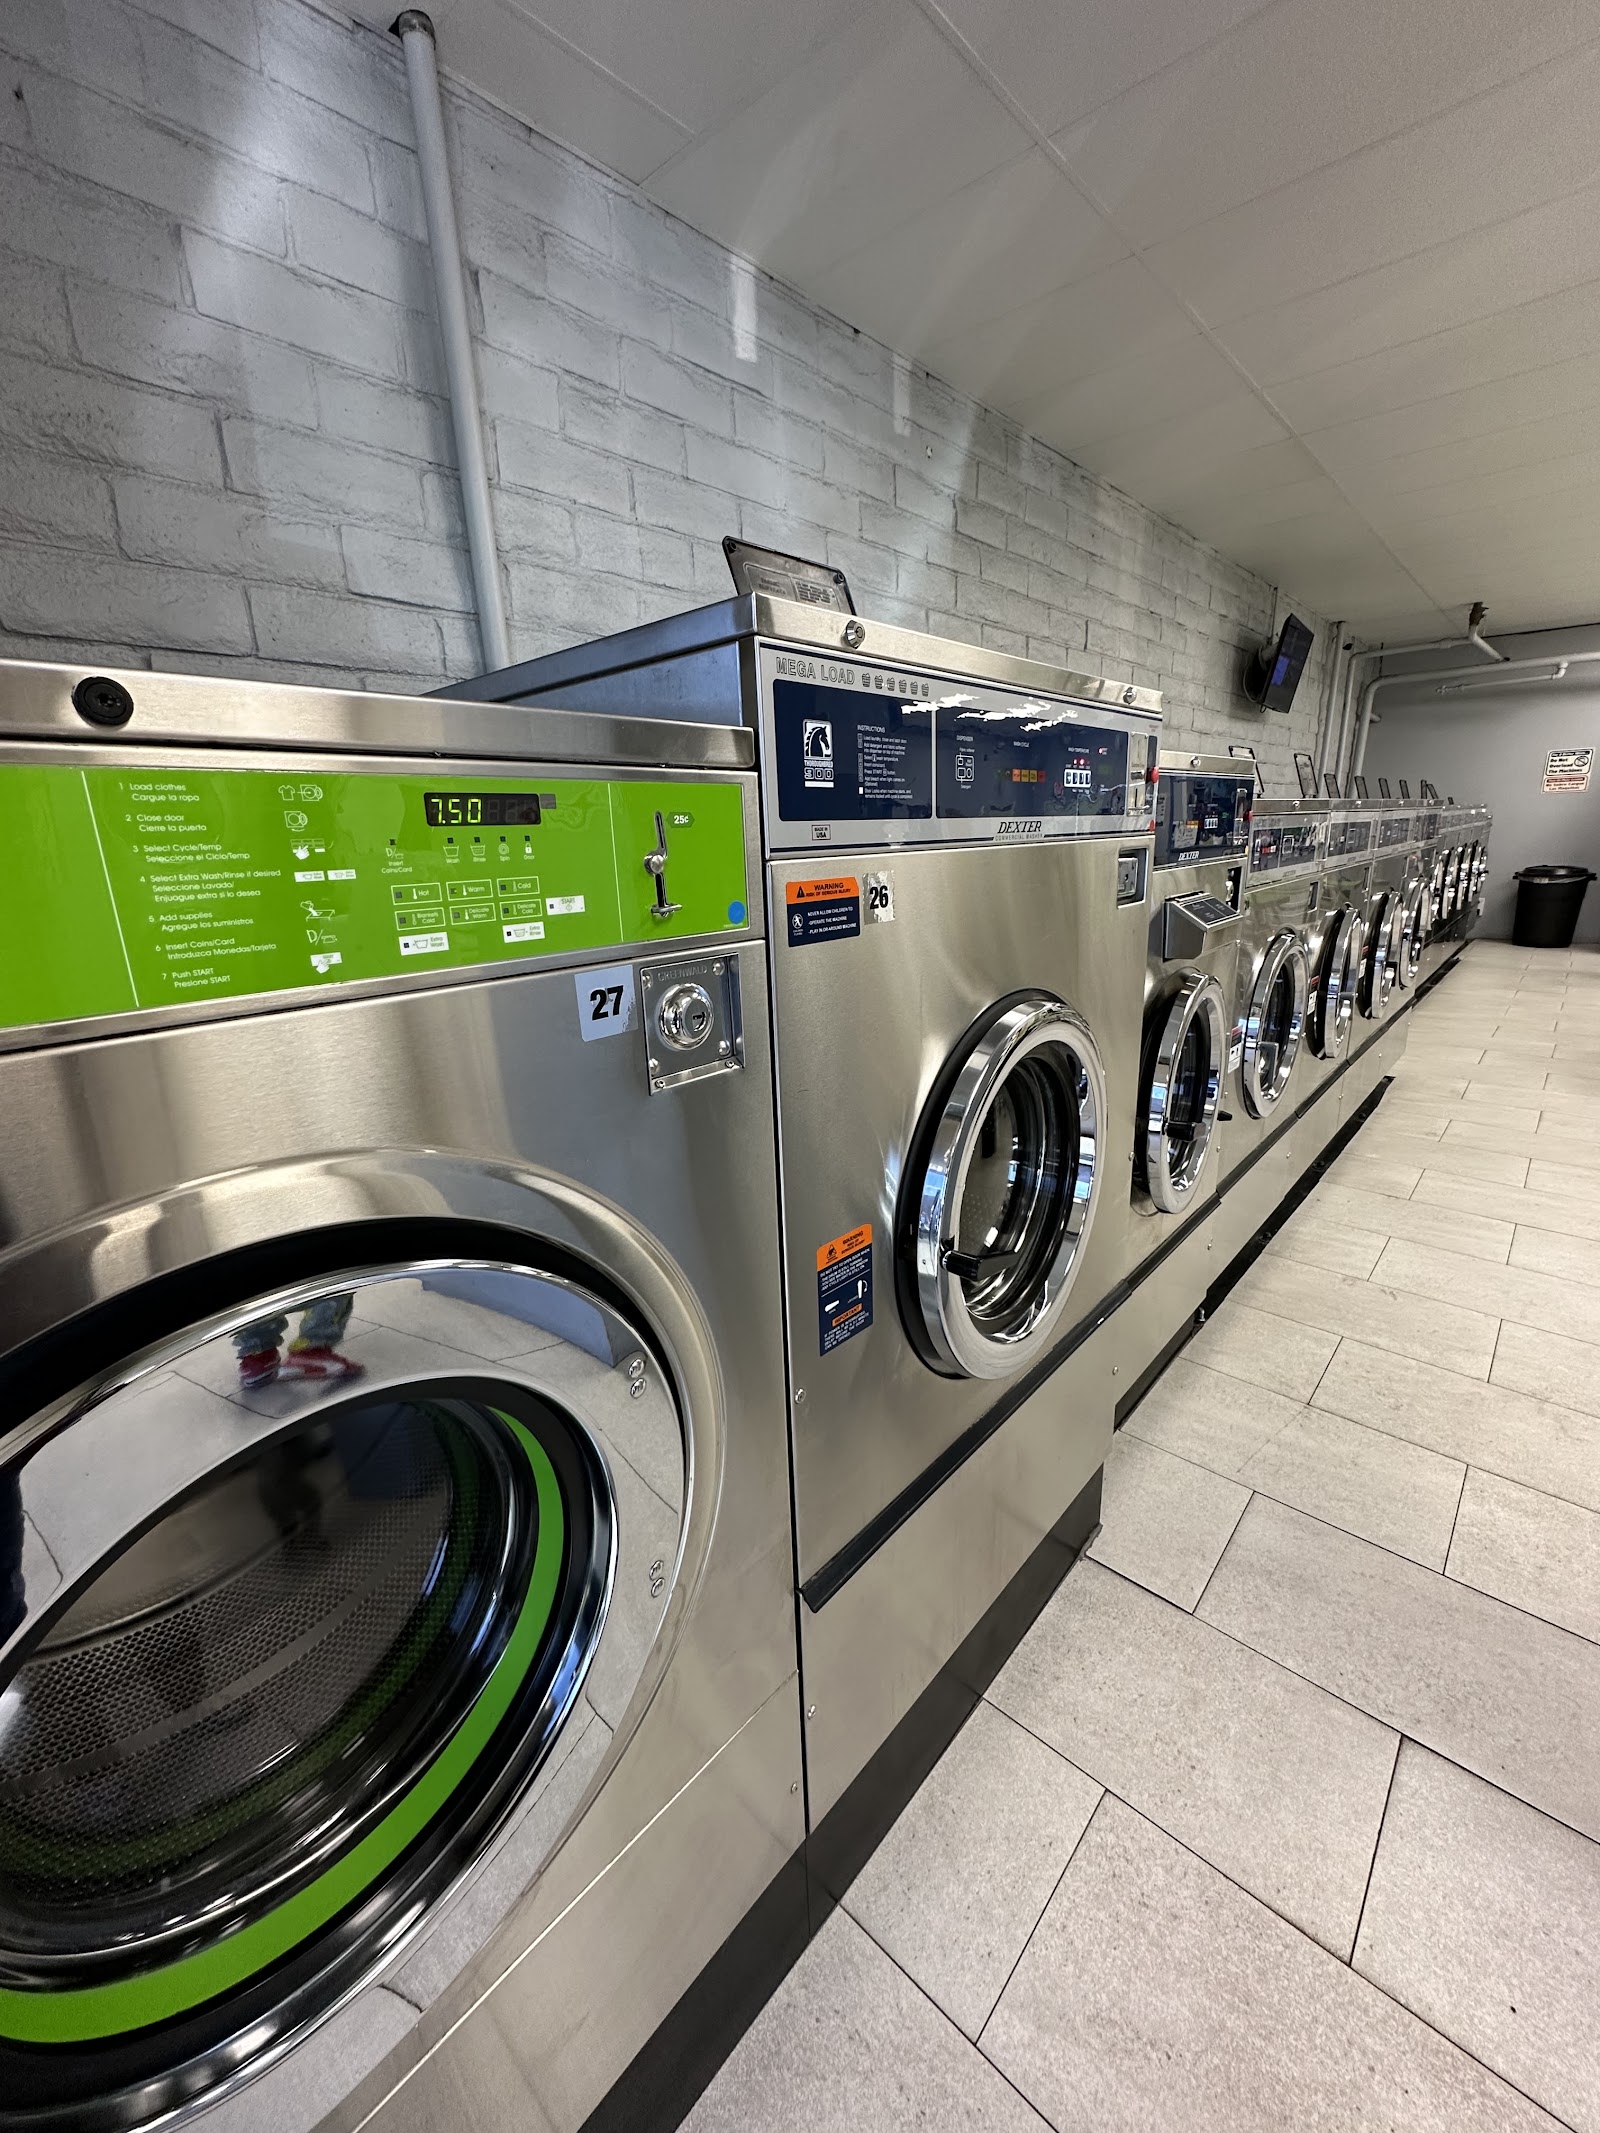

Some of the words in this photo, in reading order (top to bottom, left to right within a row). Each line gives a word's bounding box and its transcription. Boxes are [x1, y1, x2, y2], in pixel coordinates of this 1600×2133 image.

[775, 656, 816, 679] MEGA
[820, 664, 855, 685] LOAD
[118, 782, 123, 790] 1
[129, 783, 153, 791] Load
[154, 783, 186, 791] clothes
[132, 794, 166, 802] Cargue
[431, 798, 482, 824] 7.50
[125, 814, 132, 822] 2
[136, 814, 162, 822] Close
[164, 814, 184, 822] door
[674, 815, 689, 824] 25¢
[139, 824, 166, 832] Cierre
[168, 824, 178, 832] la
[179, 824, 207, 832] puerta
[997, 820, 1042, 834] DEXTER
[144, 844, 170, 852] Select
[172, 844, 222, 852] Cycle/Temp
[146, 854, 194, 862] Seleccione
[196, 853, 204, 861] el
[206, 852, 250, 860] Ciclo/Temp
[1178, 851, 1200, 861] DEXTER
[150, 875, 178, 883] Select
[200, 871, 244, 880] Wash/Rinse
[246, 870, 252, 878] if
[253, 870, 281, 878] desired
[152, 883, 200, 893] Seleccione
[202, 881, 234, 890] Lavado/
[518, 882, 532, 890] Cold
[814, 882, 844, 891] WARNING
[154, 894, 195, 902] Enjuague
[197, 892, 218, 900] extra
[226, 890, 234, 898] lo
[236, 890, 260, 898] desea
[418, 889, 430, 897] Hot
[869, 885, 889, 910] 26
[160, 914, 178, 922] Add
[180, 912, 213, 920] supplies
[162, 922, 198, 932] Agregue
[213, 918, 254, 928] suministros
[190, 938, 235, 948] Coins/Card
[168, 950, 212, 960] Introduzca
[214, 944, 276, 955] Monedas/Tarjeta
[193, 968, 214, 976] START
[657, 965, 708, 981] GREENWALD
[174, 979, 208, 988] Presione
[210, 975, 230, 984] START
[589, 985, 624, 1021] 27
